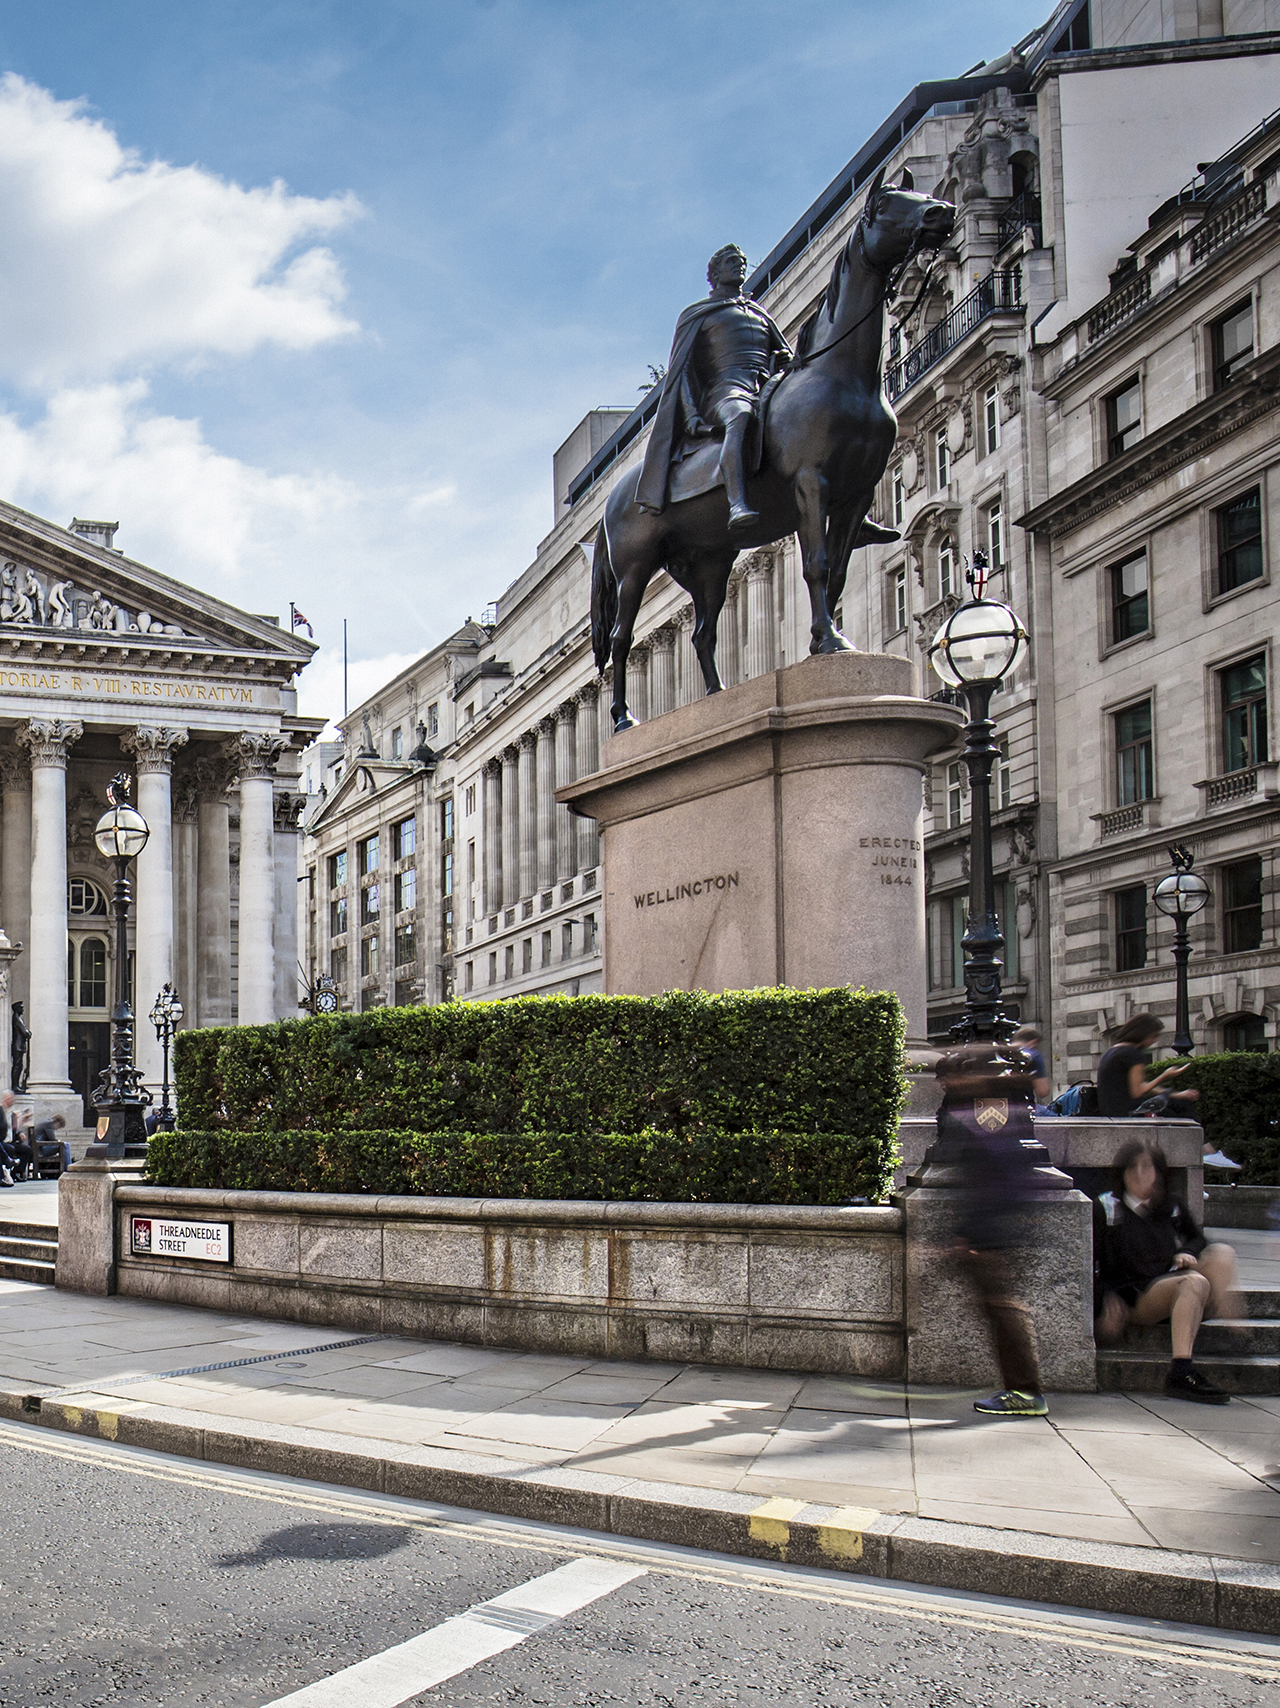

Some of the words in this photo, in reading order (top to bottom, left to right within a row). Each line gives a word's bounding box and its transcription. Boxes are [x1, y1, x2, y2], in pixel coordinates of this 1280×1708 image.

[72, 677, 83, 691] R
[93, 678, 120, 693] VIII
[131, 680, 253, 703] RESTAVRATVM
[859, 836, 921, 851] ERECTED
[872, 856, 908, 868] JUNE
[880, 874, 912, 886] 1844
[634, 871, 740, 909] WELLINGTON
[159, 1225, 221, 1241] THREADNEEDLE
[159, 1239, 186, 1252] STREET
[206, 1243, 222, 1256] EC2
